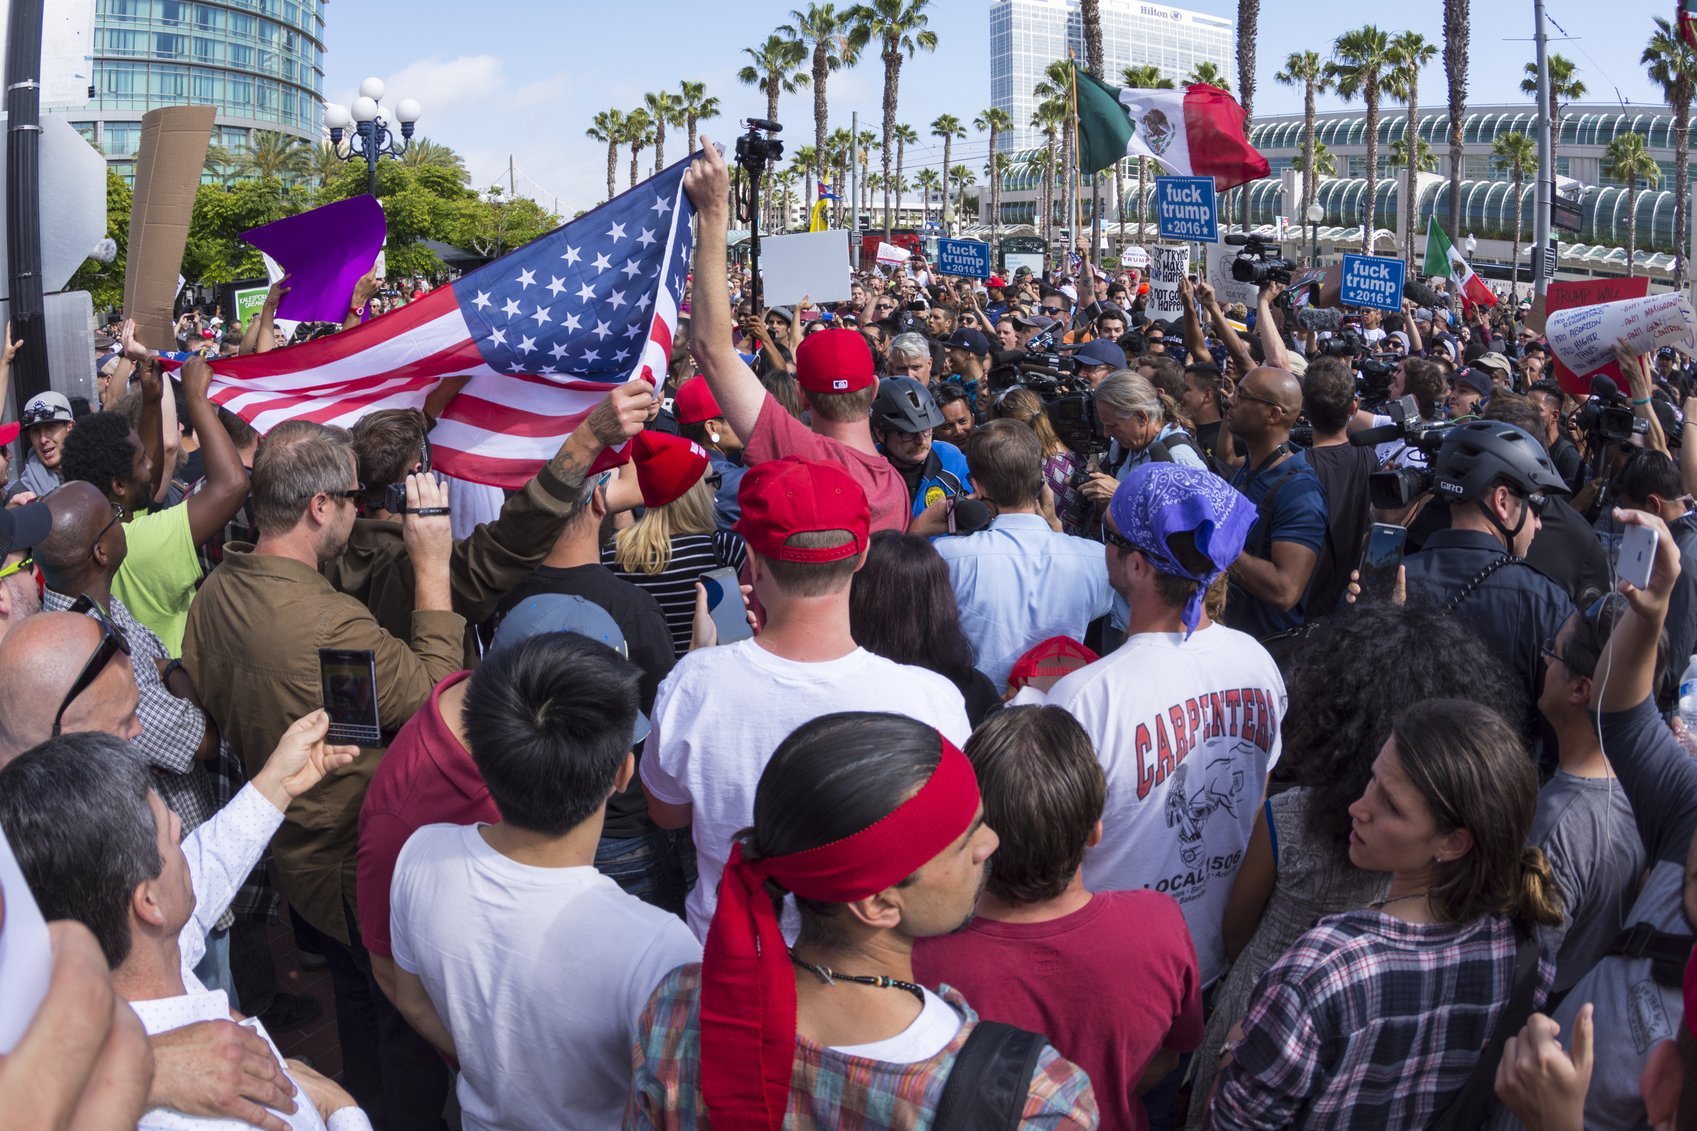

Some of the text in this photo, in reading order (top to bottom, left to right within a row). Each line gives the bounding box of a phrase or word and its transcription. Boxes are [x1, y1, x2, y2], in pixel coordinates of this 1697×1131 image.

[1141, 6, 1168, 18] Hilton
[1166, 184, 1202, 203] fuck
[1162, 201, 1210, 224] trump
[1174, 221, 1200, 235] 2016
[946, 243, 978, 257] fuck
[942, 253, 984, 268] trump
[952, 264, 975, 274] 2016
[1353, 260, 1390, 279] fuck
[1346, 273, 1396, 296] trump
[1356, 290, 1384, 304] 2016
[1553, 287, 1591, 304] TRUMP
[1598, 286, 1622, 301] WILL
[1569, 316, 1602, 337] ABORTION
[1646, 318, 1663, 333] GUN
[1654, 325, 1685, 338] CONTROL
[1575, 344, 1599, 359] TAXES
[1440, 481, 1464, 494] GIRO
[1144, 868, 1205, 893] OCAL
